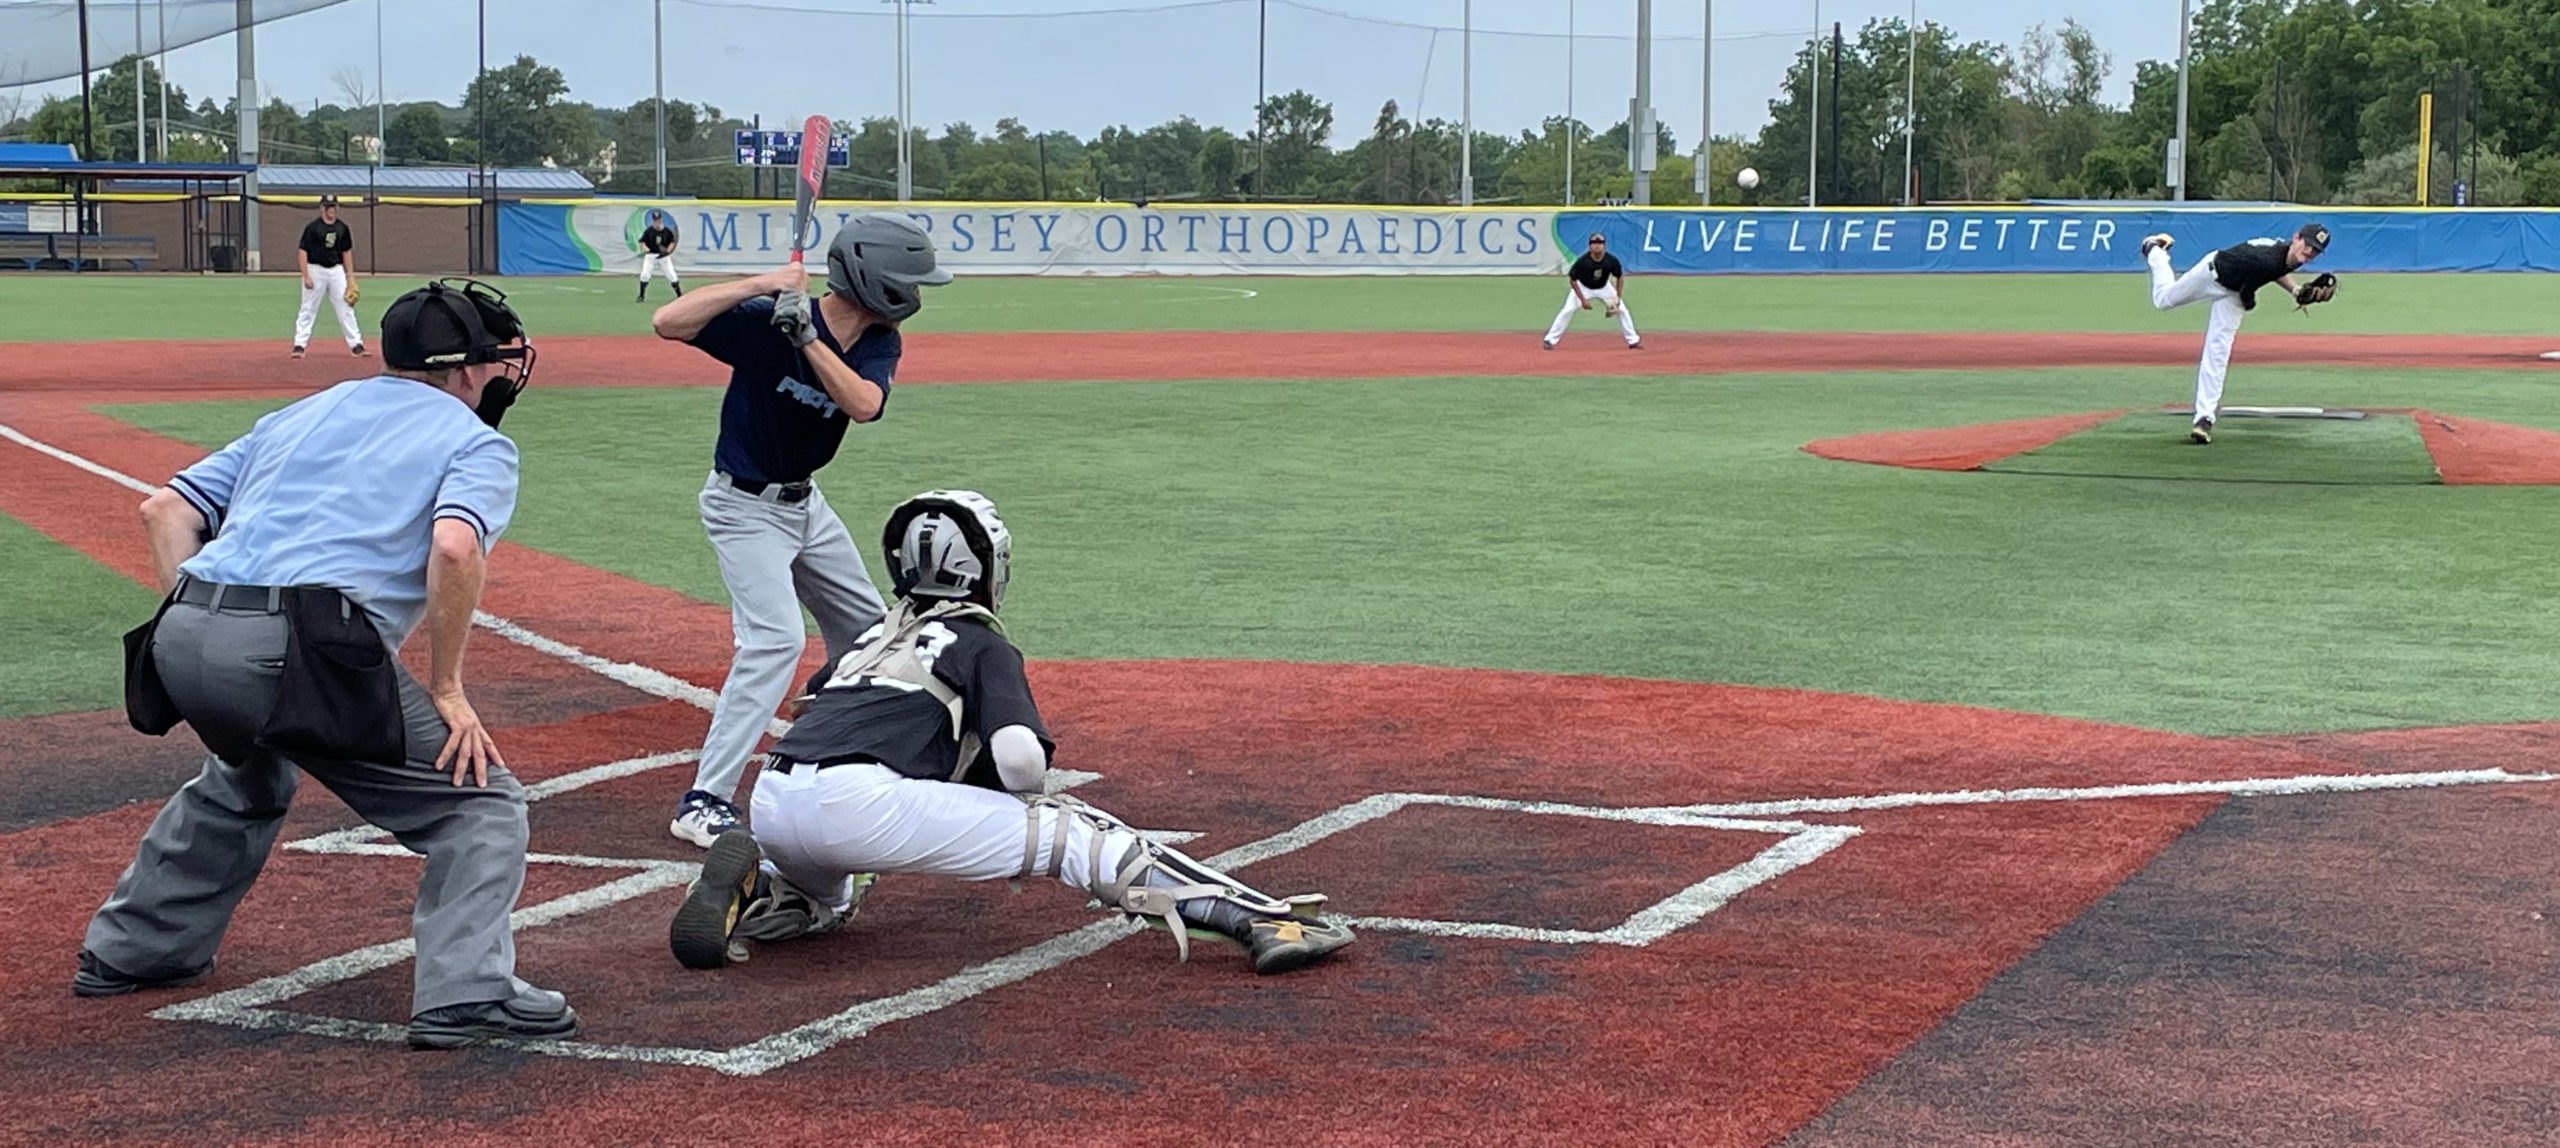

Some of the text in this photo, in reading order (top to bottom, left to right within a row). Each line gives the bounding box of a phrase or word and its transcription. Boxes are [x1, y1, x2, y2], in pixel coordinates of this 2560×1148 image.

[1095, 214, 1538, 256] ORTHOPAEDICS
[1643, 219, 2116, 253] LIVE LIFE BETTER
